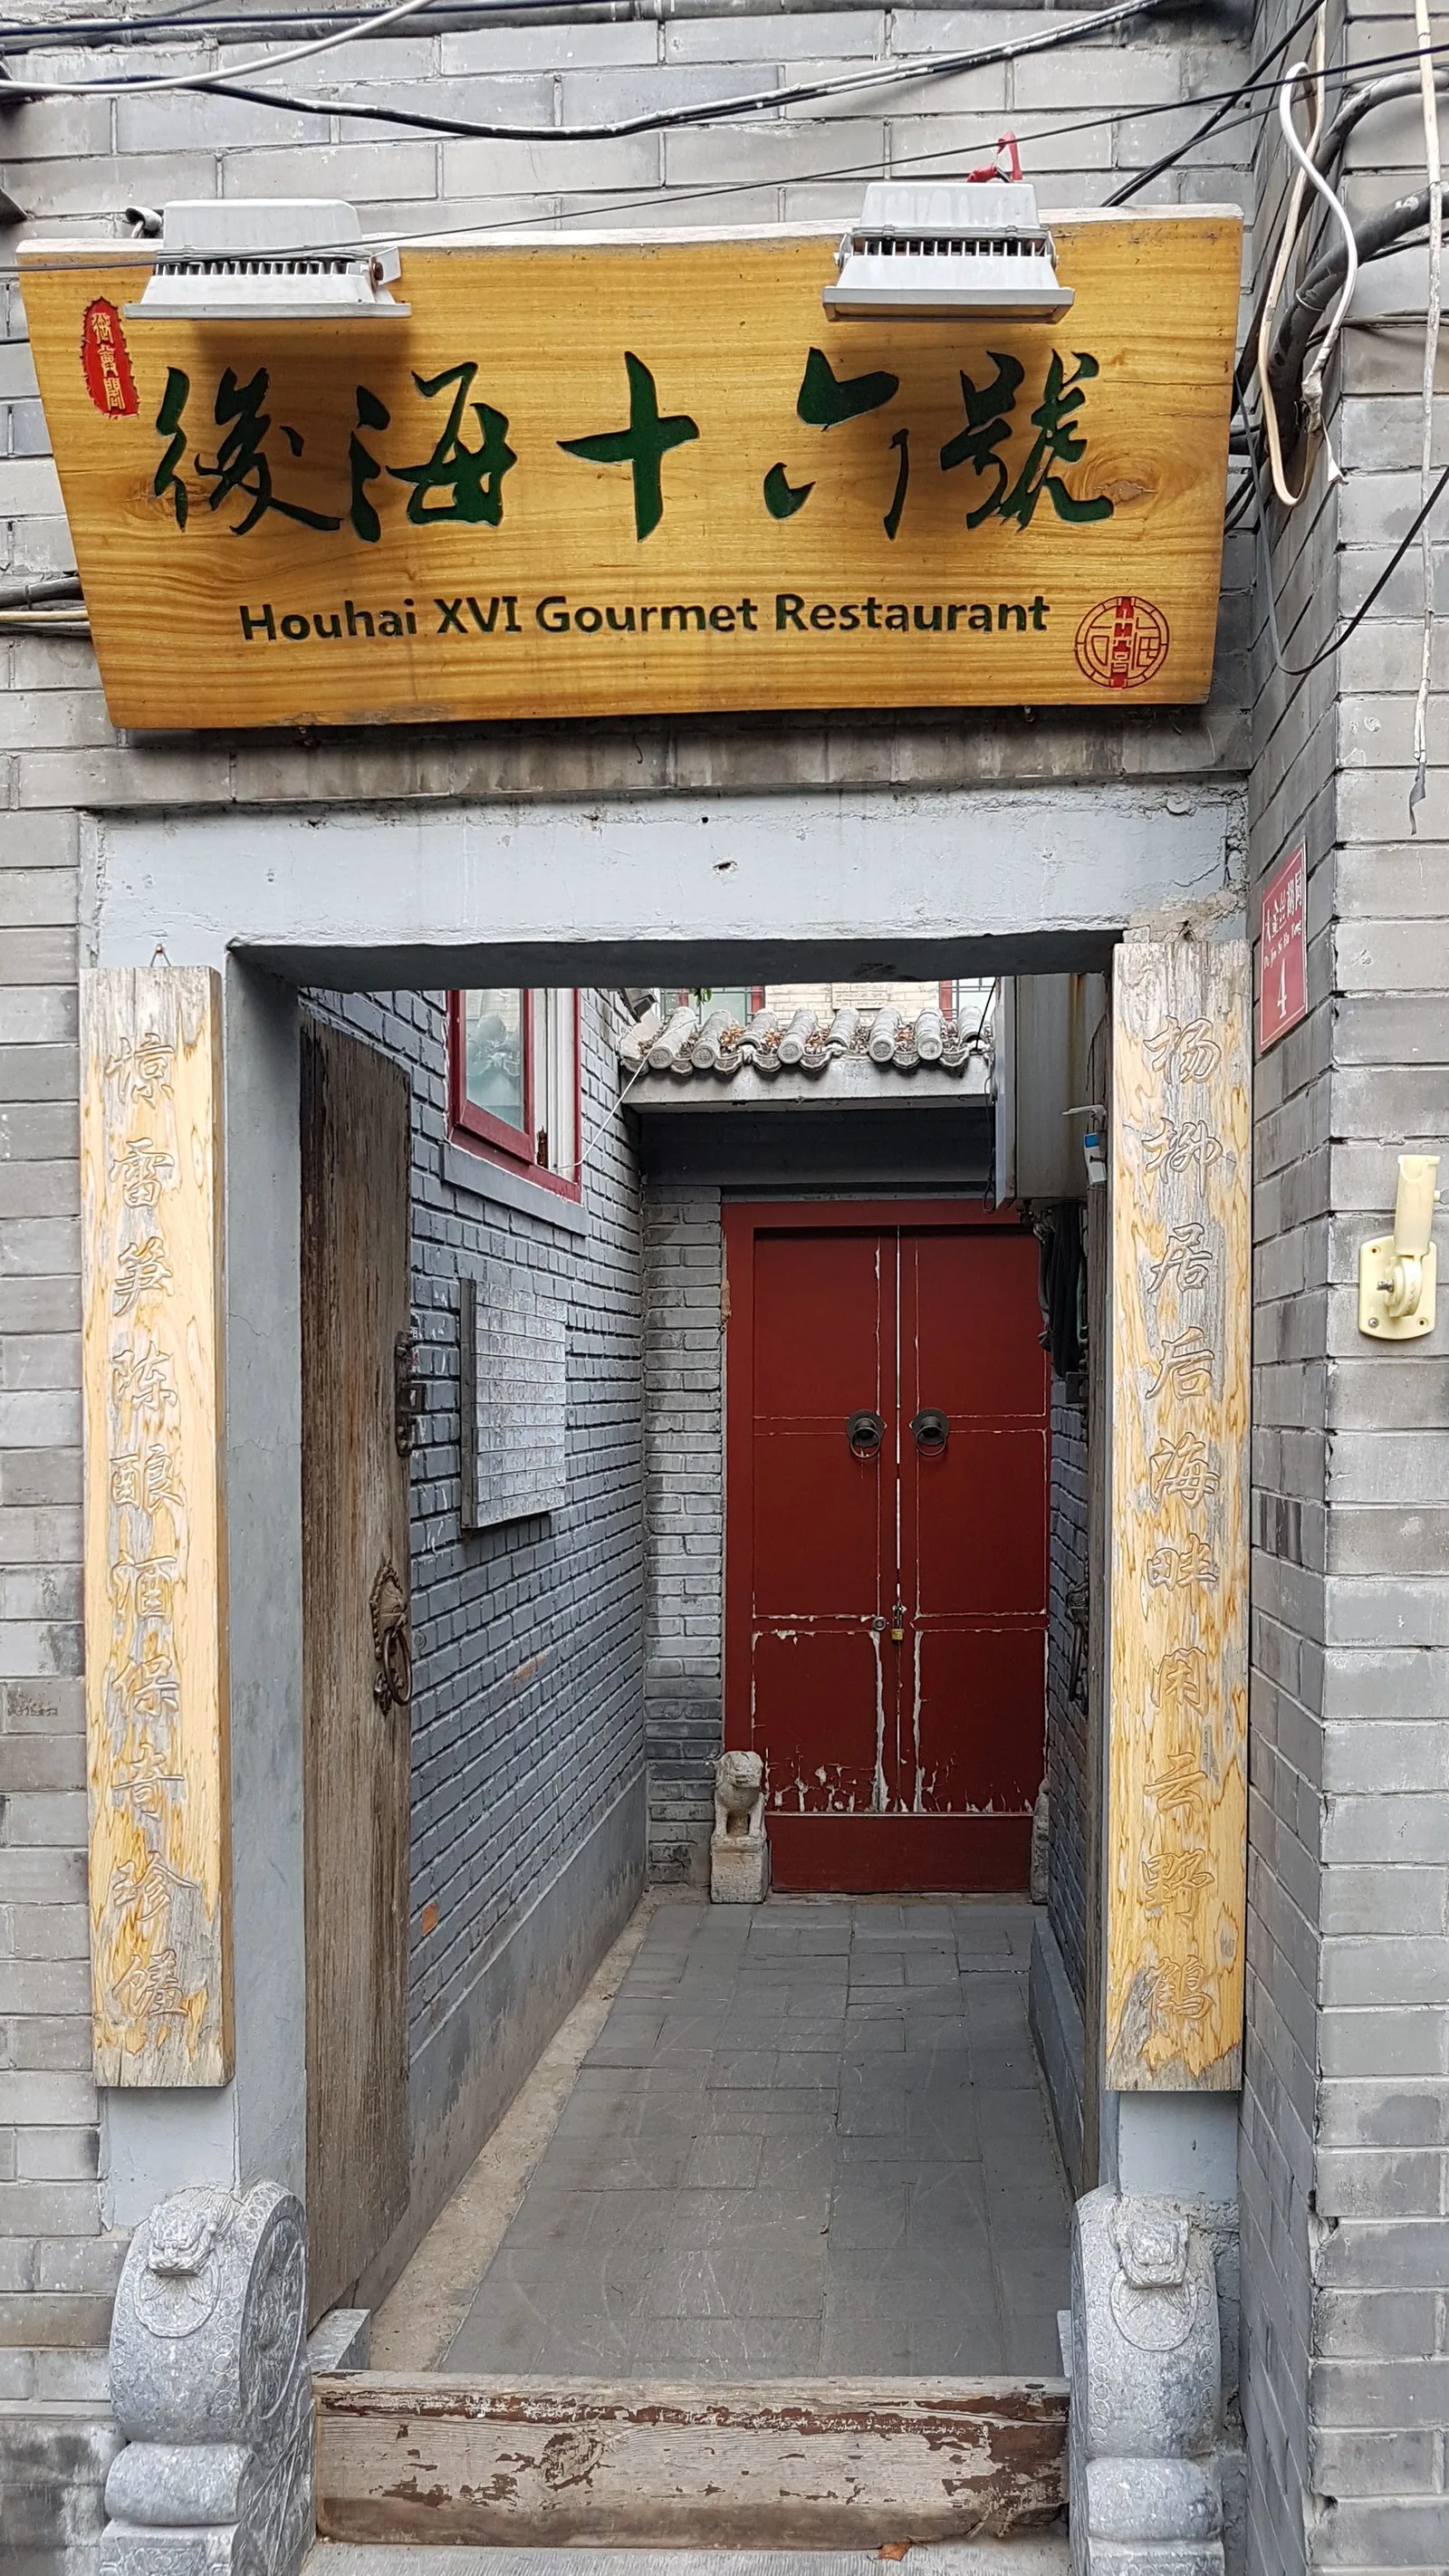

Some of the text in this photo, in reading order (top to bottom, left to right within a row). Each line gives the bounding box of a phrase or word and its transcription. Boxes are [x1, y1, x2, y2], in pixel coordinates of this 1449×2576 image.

[238, 592, 1051, 641] Houhai XVI Gourmet Restaurant
[1277, 957, 1288, 1020] 4
